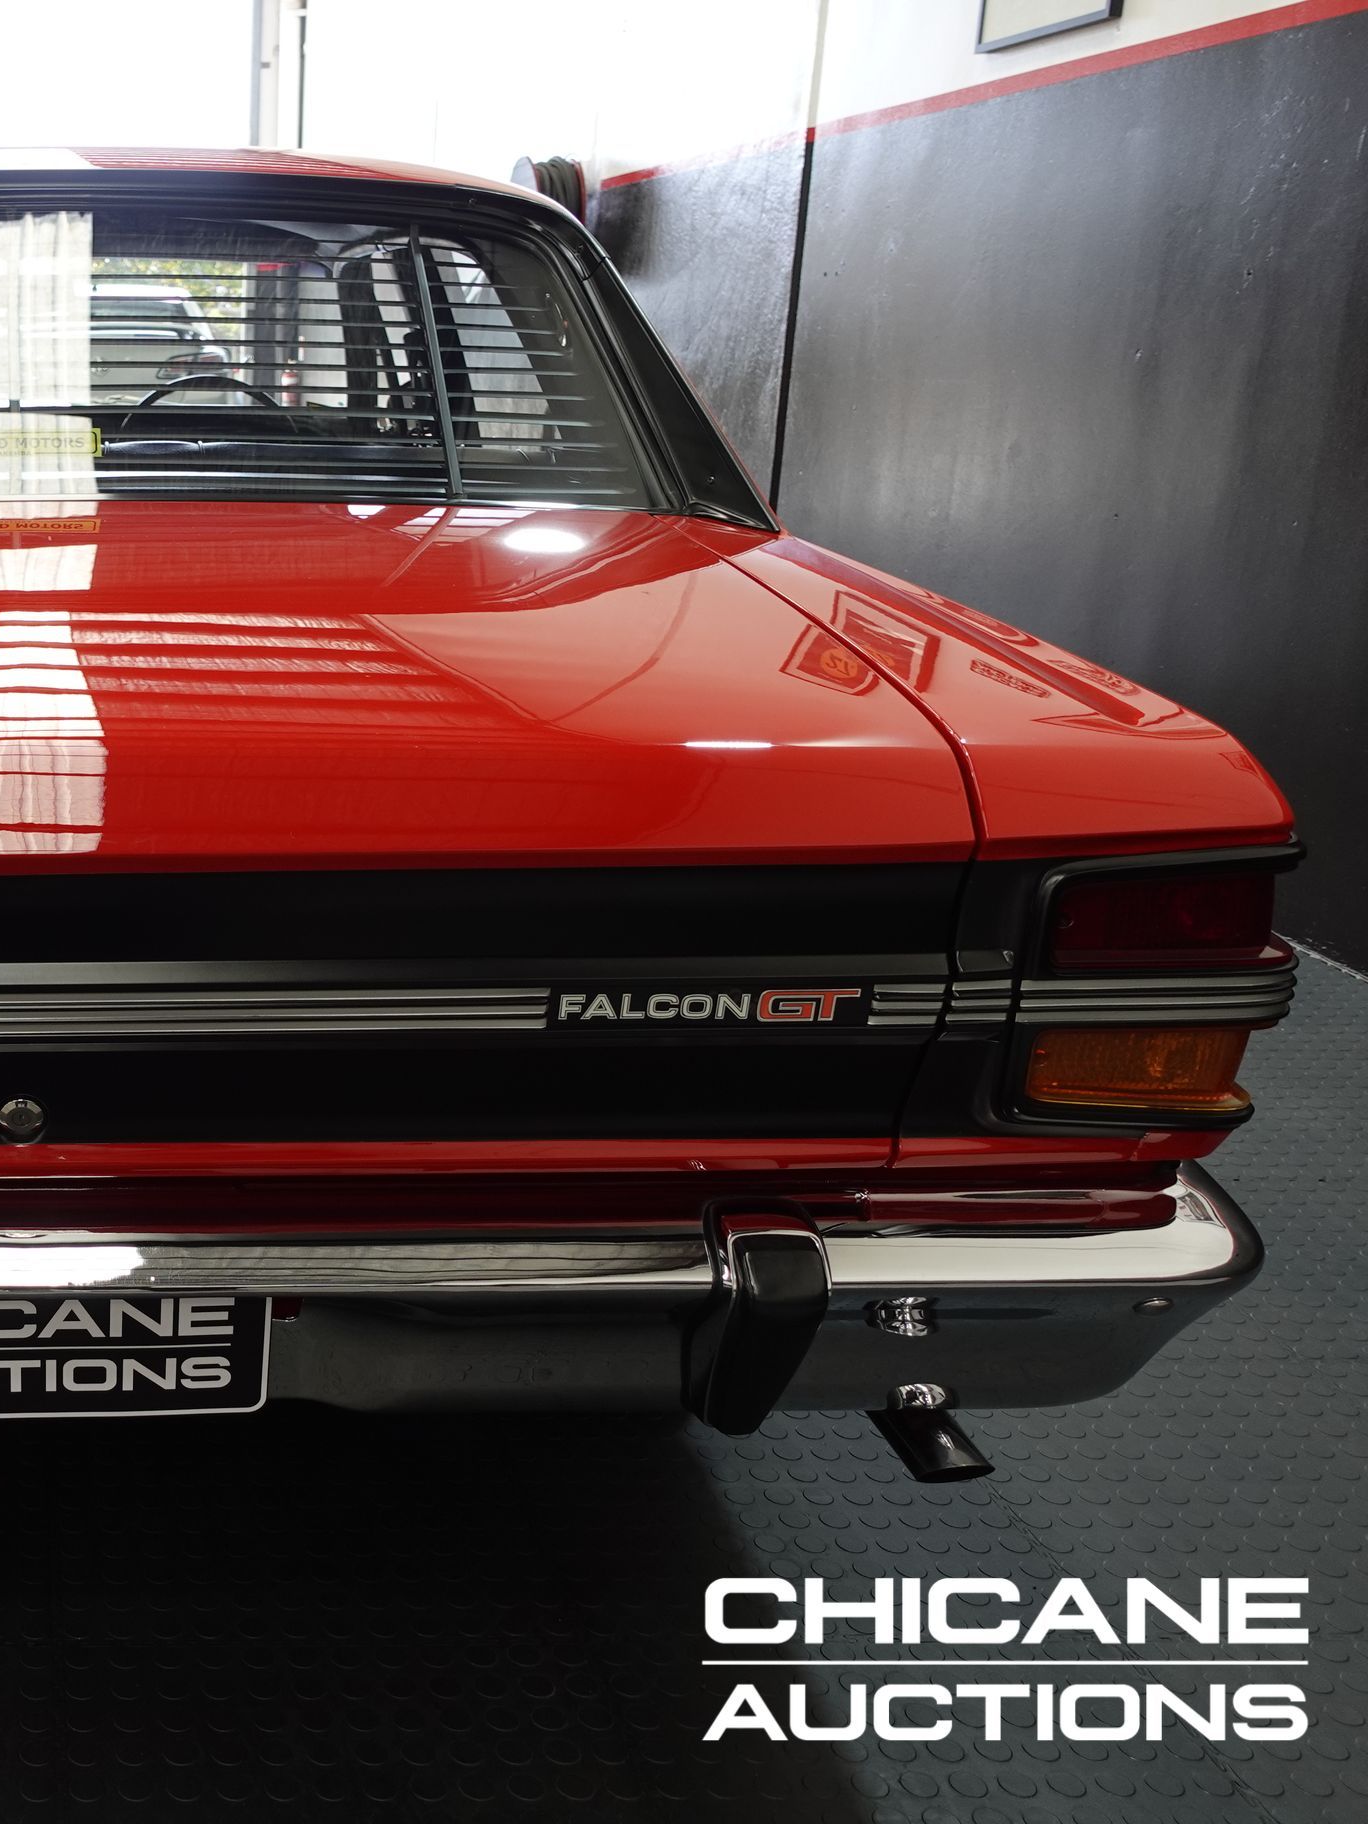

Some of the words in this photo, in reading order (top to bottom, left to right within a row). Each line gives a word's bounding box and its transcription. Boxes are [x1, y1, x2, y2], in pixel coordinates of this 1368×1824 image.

[15, 437, 85, 449] MOTORS
[558, 993, 752, 1020] FALCON
[757, 988, 862, 1022] GT
